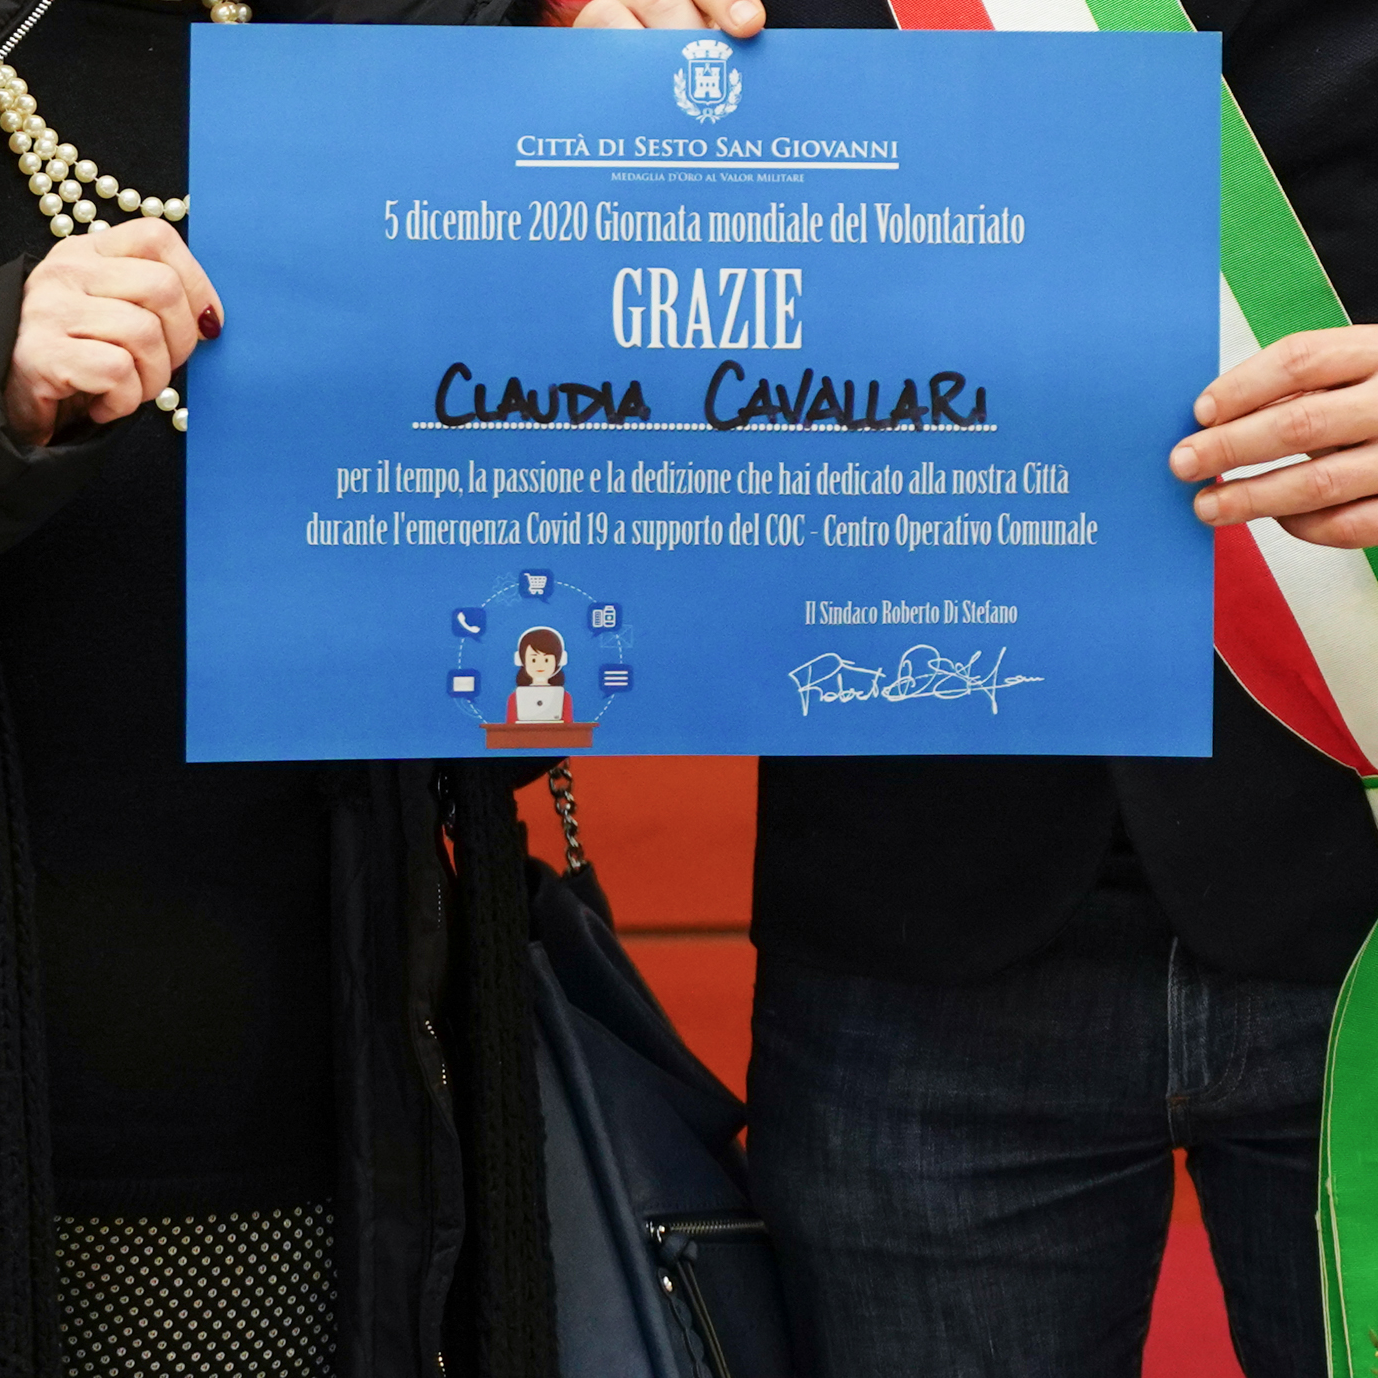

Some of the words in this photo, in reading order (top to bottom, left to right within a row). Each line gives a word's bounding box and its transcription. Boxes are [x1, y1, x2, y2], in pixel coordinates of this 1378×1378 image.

[516, 133, 591, 157] CITTÀ
[598, 138, 625, 157] DI
[634, 135, 708, 157] SESTO
[715, 136, 763, 158] SAN
[770, 136, 899, 159] GIOVANNI
[610, 171, 666, 182] MEDAGLIA
[720, 172, 754, 183] VALOR
[756, 173, 805, 183] MILITARE
[384, 199, 399, 240] 5
[405, 199, 522, 241] dicembre
[528, 200, 589, 242] 2020
[594, 200, 703, 242] Giornata
[708, 201, 824, 244] mondiale
[829, 202, 868, 244] del
[873, 202, 1026, 245] Volontariato
[612, 267, 803, 350] GRAZIE
[336, 467, 373, 500] per
[376, 459, 390, 494] il
[395, 462, 464, 499] tempo,
[467, 459, 488, 494] la
[492, 460, 585, 499] passione
[589, 468, 602, 493] e
[606, 460, 627, 494] la
[630, 460, 732, 495] dedizione
[736, 461, 773, 496] che
[778, 461, 812, 496] hai
[815, 462, 904, 496] dedicato
[908, 461, 947, 495] alla
[951, 463, 1019, 495] nostra
[1022, 461, 1070, 495] Città
[306, 511, 389, 546] durante
[393, 511, 522, 547] l'emergenza
[526, 511, 581, 546] Covid
[586, 511, 609, 546] 19
[613, 519, 627, 545] a
[631, 514, 724, 551] supporto
[728, 512, 760, 547] del
[765, 513, 806, 547] COC
[823, 513, 890, 548] Centro
[894, 512, 992, 553] Operativo
[997, 511, 1099, 547] Comunale
[804, 600, 816, 626] Il
[819, 600, 878, 626] Sindaco
[881, 599, 940, 625] Roberto
[943, 599, 959, 625] Di
[962, 599, 1018, 625] Stefano
